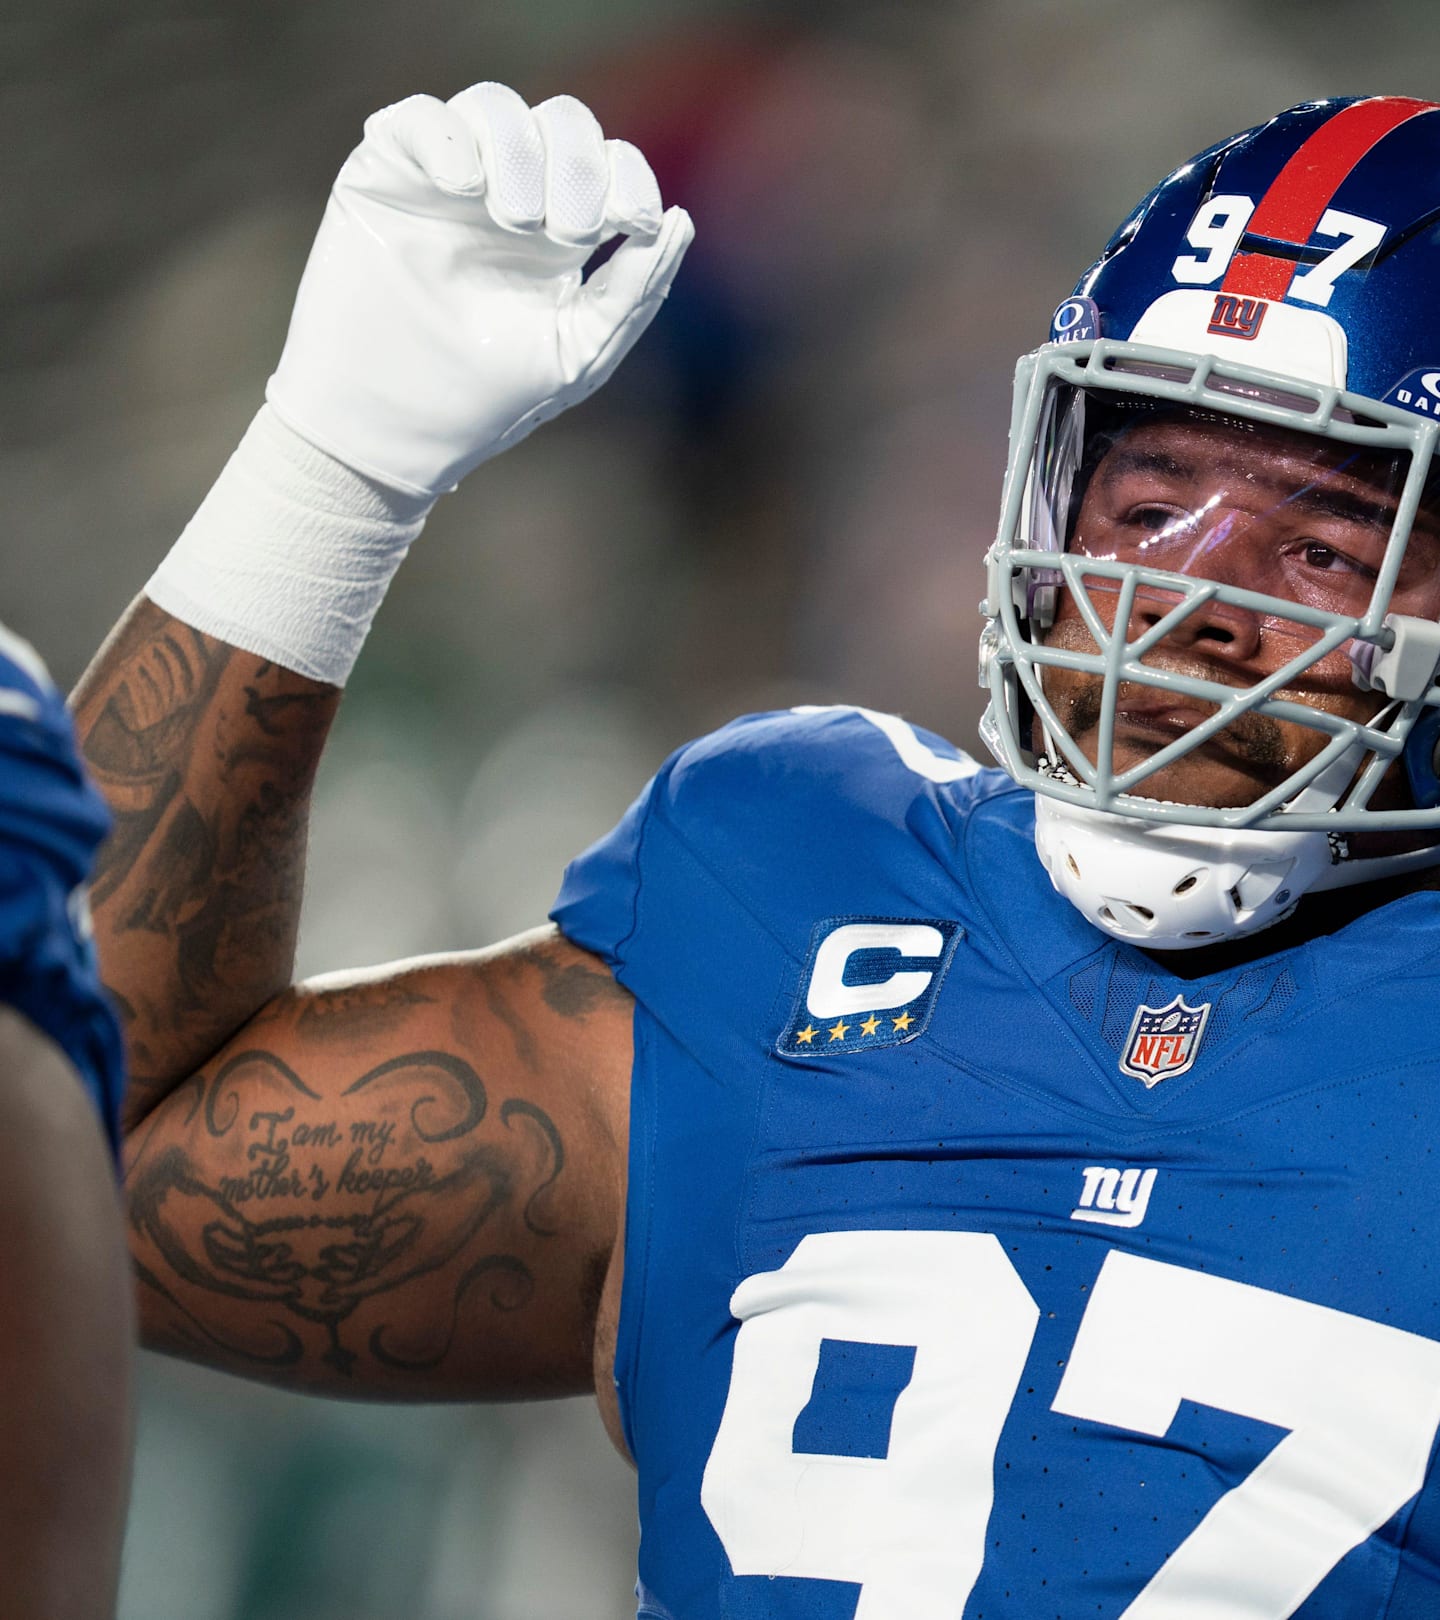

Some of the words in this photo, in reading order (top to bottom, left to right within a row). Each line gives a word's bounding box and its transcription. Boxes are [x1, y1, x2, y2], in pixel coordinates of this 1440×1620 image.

[806, 923, 944, 1020] C
[1132, 1035, 1186, 1069] NFL
[248, 1106, 295, 1160] I
[292, 1121, 343, 1148] am
[350, 1119, 397, 1165] my
[220, 1153, 330, 1203] mother's
[335, 1147, 437, 1210] keeper
